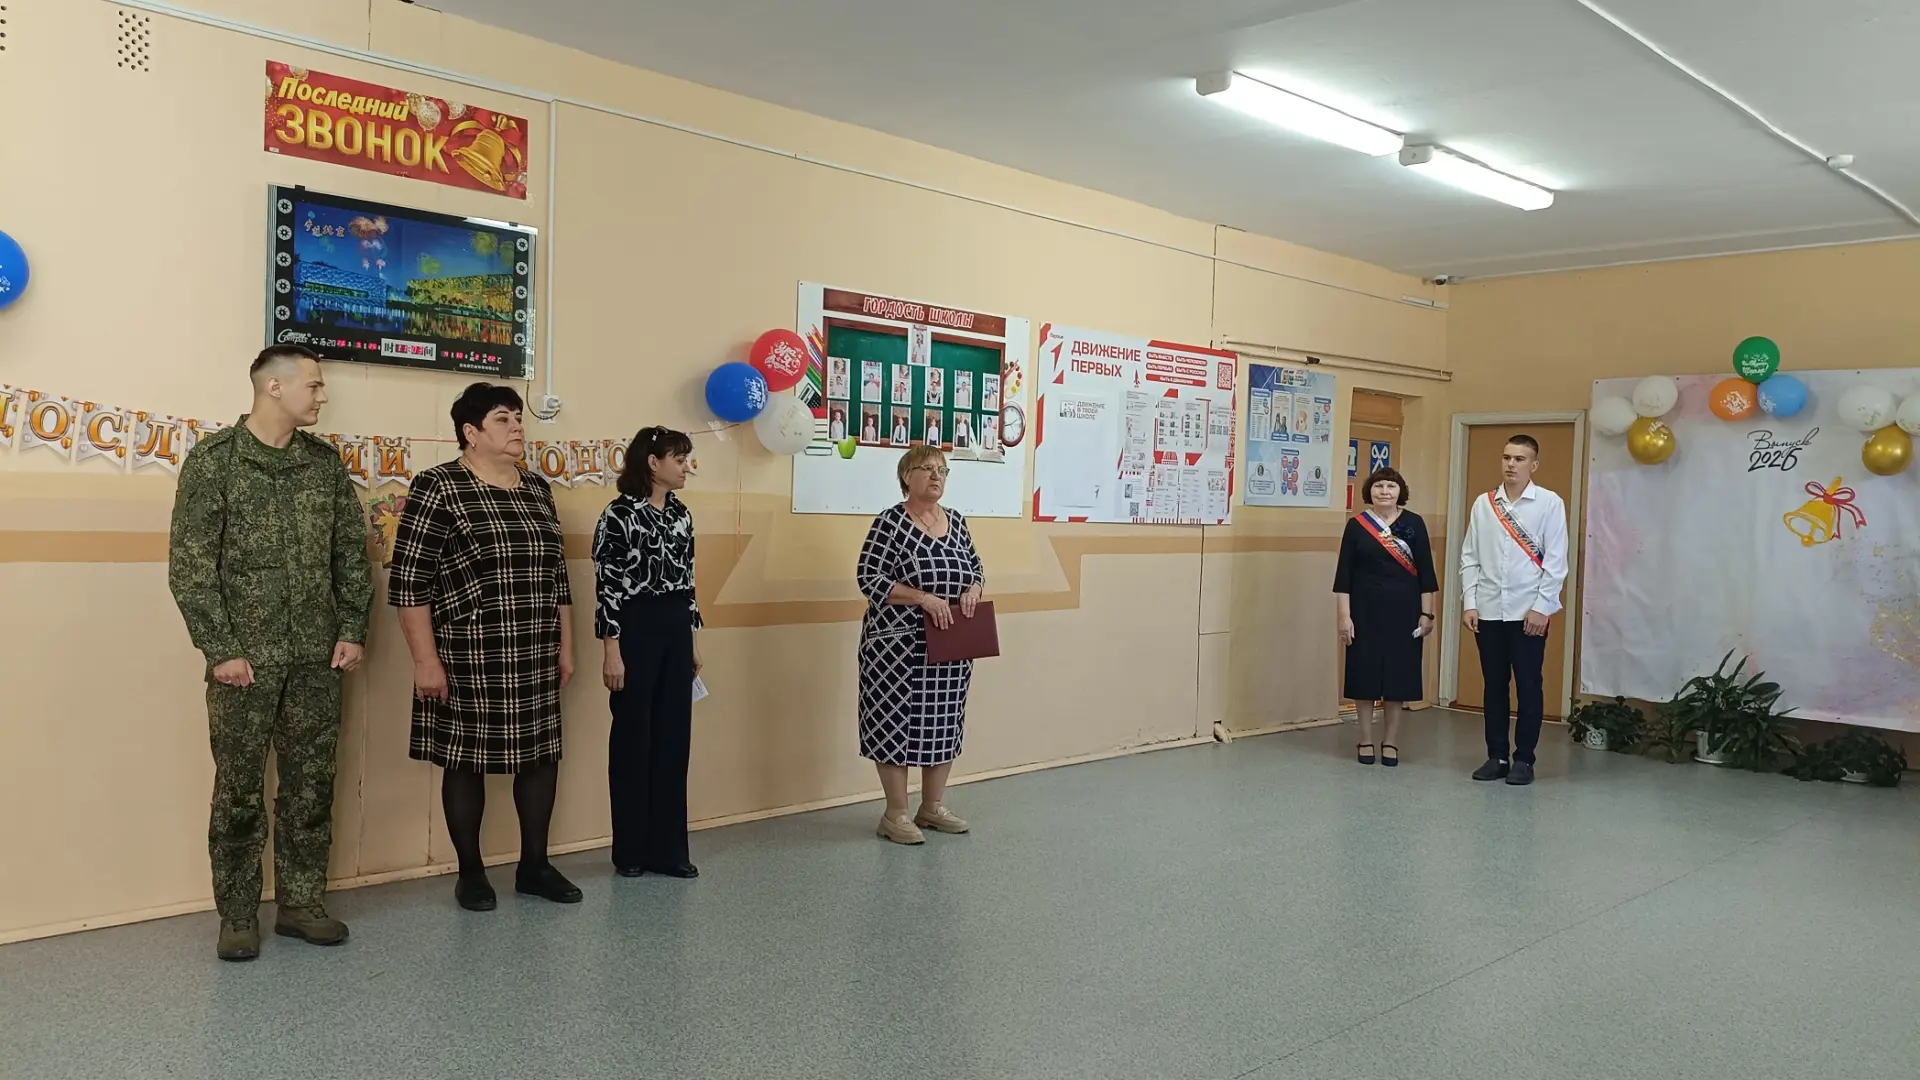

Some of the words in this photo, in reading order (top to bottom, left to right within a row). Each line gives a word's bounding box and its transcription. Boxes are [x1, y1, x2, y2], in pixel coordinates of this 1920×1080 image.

[278, 76, 410, 122] Последний
[275, 103, 450, 175] ЗВОНОК
[863, 296, 925, 321] ГОРДОСТЬ
[928, 307, 975, 329] ШКОЛЫ
[1071, 340, 1141, 362] ДВИЖЕНИЕ
[1071, 359, 1122, 377] ПЕРВЫХ
[1077, 401, 1105, 409] ДВИЖЕНИЕ
[1747, 427, 1820, 458] Выпуск
[1748, 448, 1803, 472] 2026
